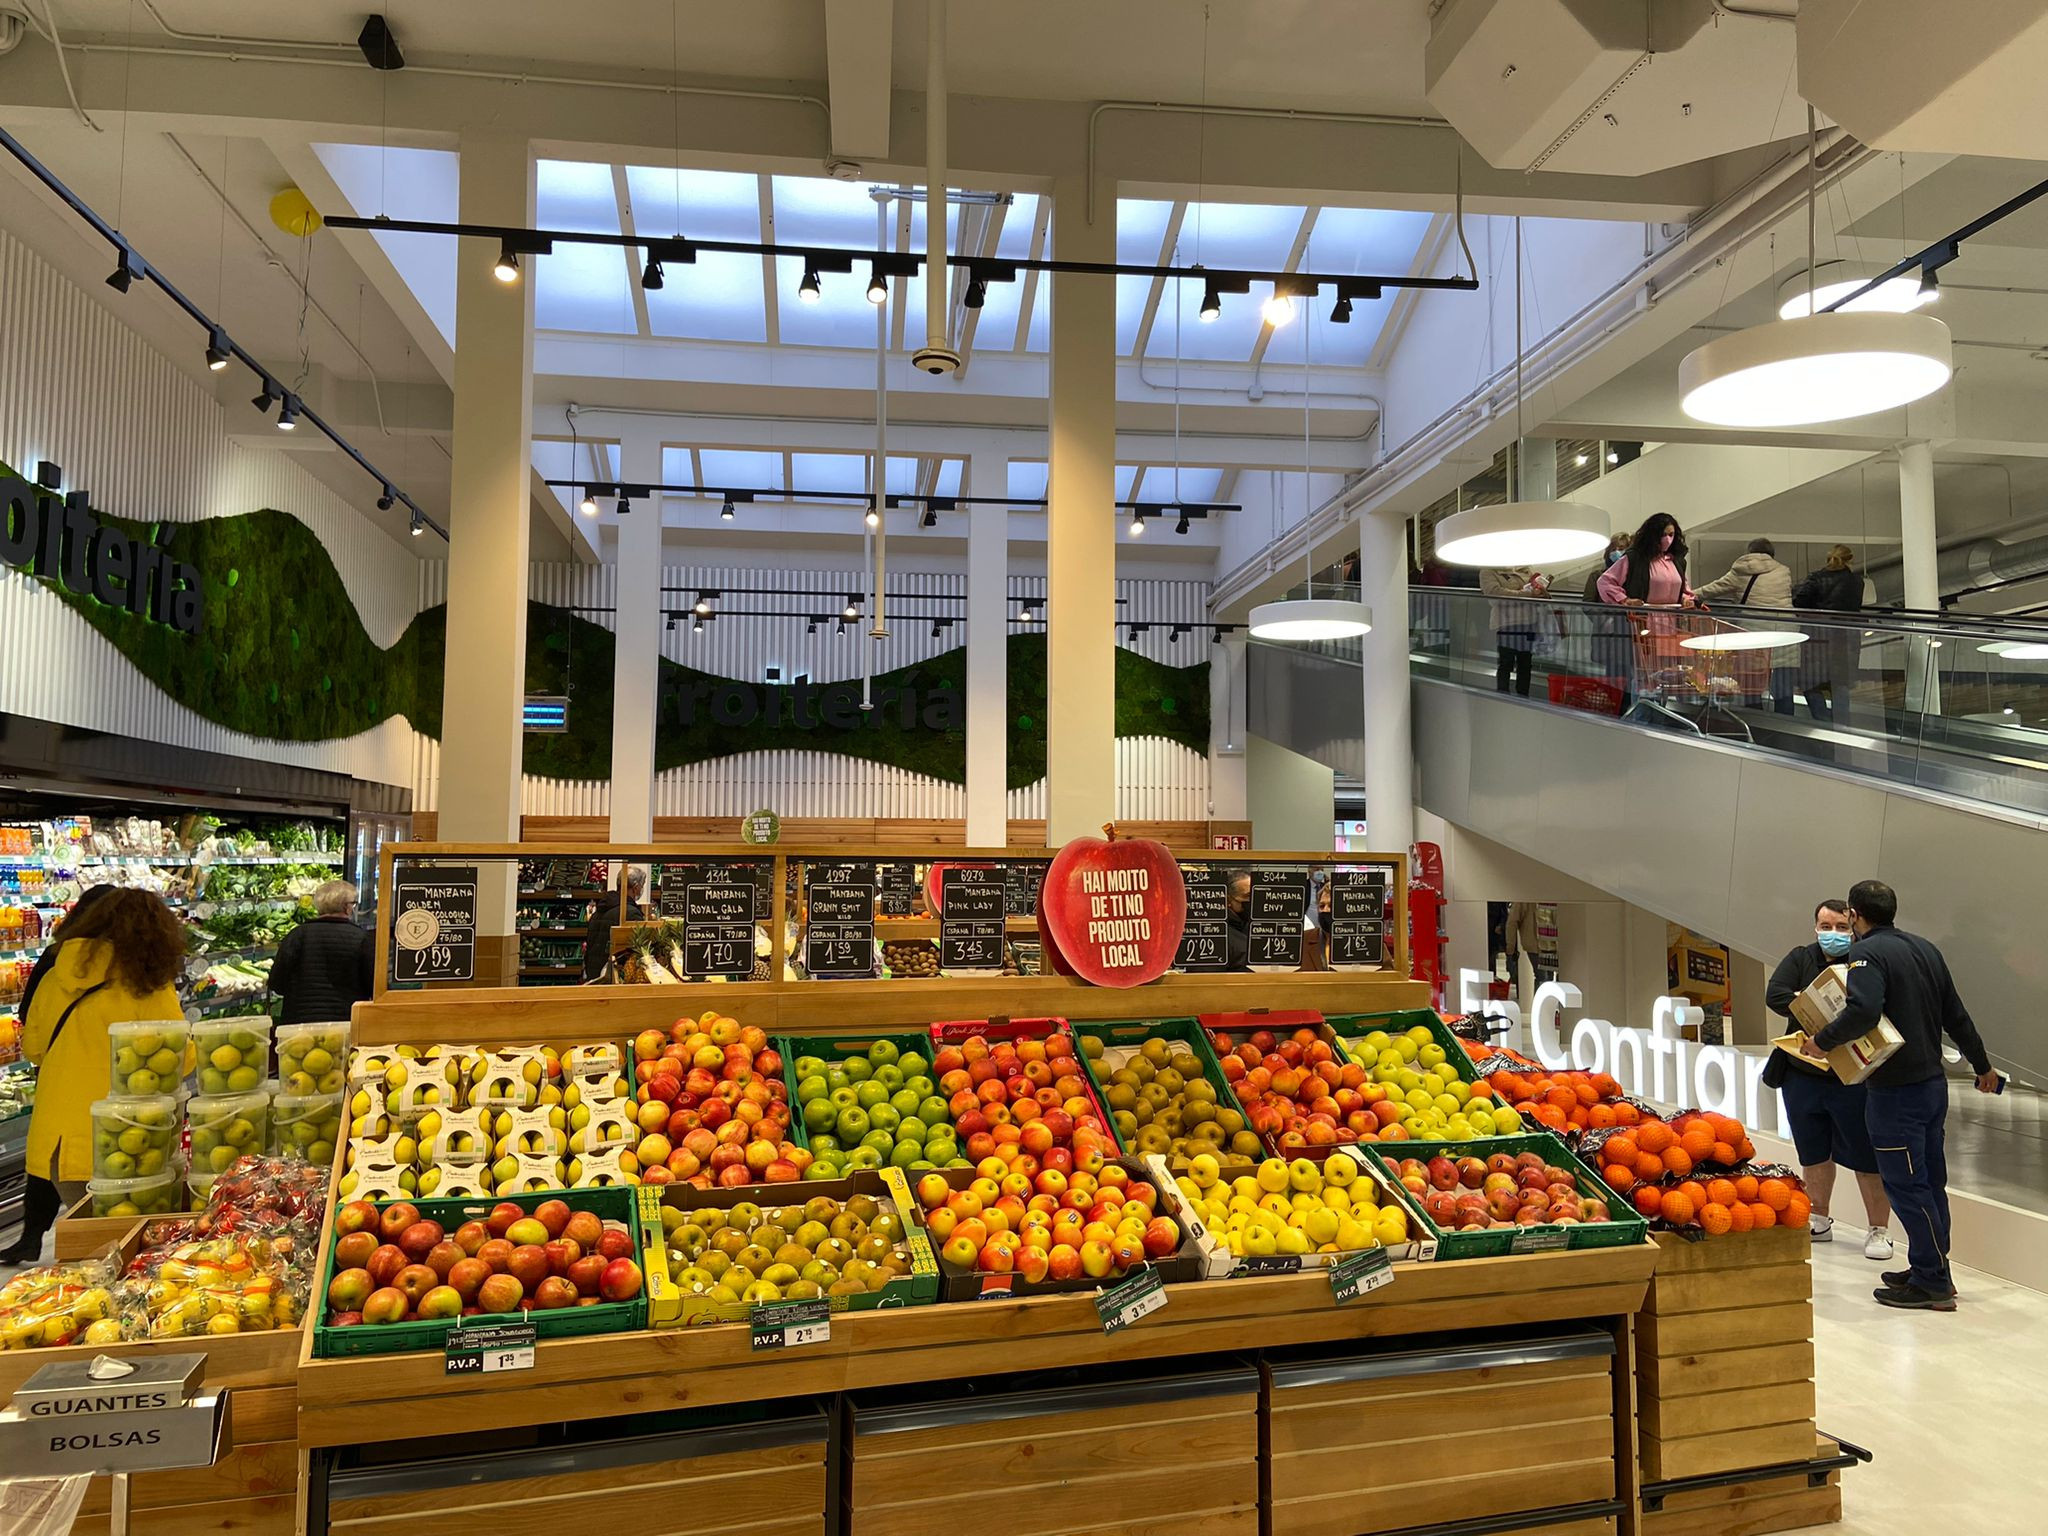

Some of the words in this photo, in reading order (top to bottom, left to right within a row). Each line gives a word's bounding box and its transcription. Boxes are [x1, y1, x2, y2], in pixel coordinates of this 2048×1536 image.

[706, 869, 732, 883] 1311
[826, 869, 852, 883] 1297
[961, 869, 986, 882] 6272
[1083, 871, 1105, 893] HAI
[1106, 868, 1149, 892] MOITO
[425, 887, 473, 898] MANZANA
[706, 890, 748, 900] MANZANA
[830, 890, 866, 898] MANZANA
[965, 888, 1002, 896] MANZANA
[1265, 892, 1302, 900] MANZANA
[1343, 892, 1375, 900] MANZANA
[406, 900, 441, 909] GOLDEN
[691, 904, 718, 914] ROYAL
[721, 904, 743, 914] GALA
[841, 903, 861, 912] SMIT
[948, 902, 969, 910] PINK
[973, 902, 994, 910] LADY
[1091, 895, 1109, 918] DE
[1110, 894, 1124, 917] TI
[1125, 893, 1144, 916] NO
[1263, 903, 1283, 912] ENVY
[1346, 903, 1371, 912] GOLDEN
[1088, 918, 1151, 943] PRODUTO
[1263, 938, 1287, 959] 1'99
[1101, 943, 1144, 968] LOCAL
[754, 1334, 782, 1346] P.V.P.
[448, 1358, 480, 1370] P.V.P.
[30, 1393, 167, 1416] GUANTES
[50, 1429, 161, 1451] BOLSAS
